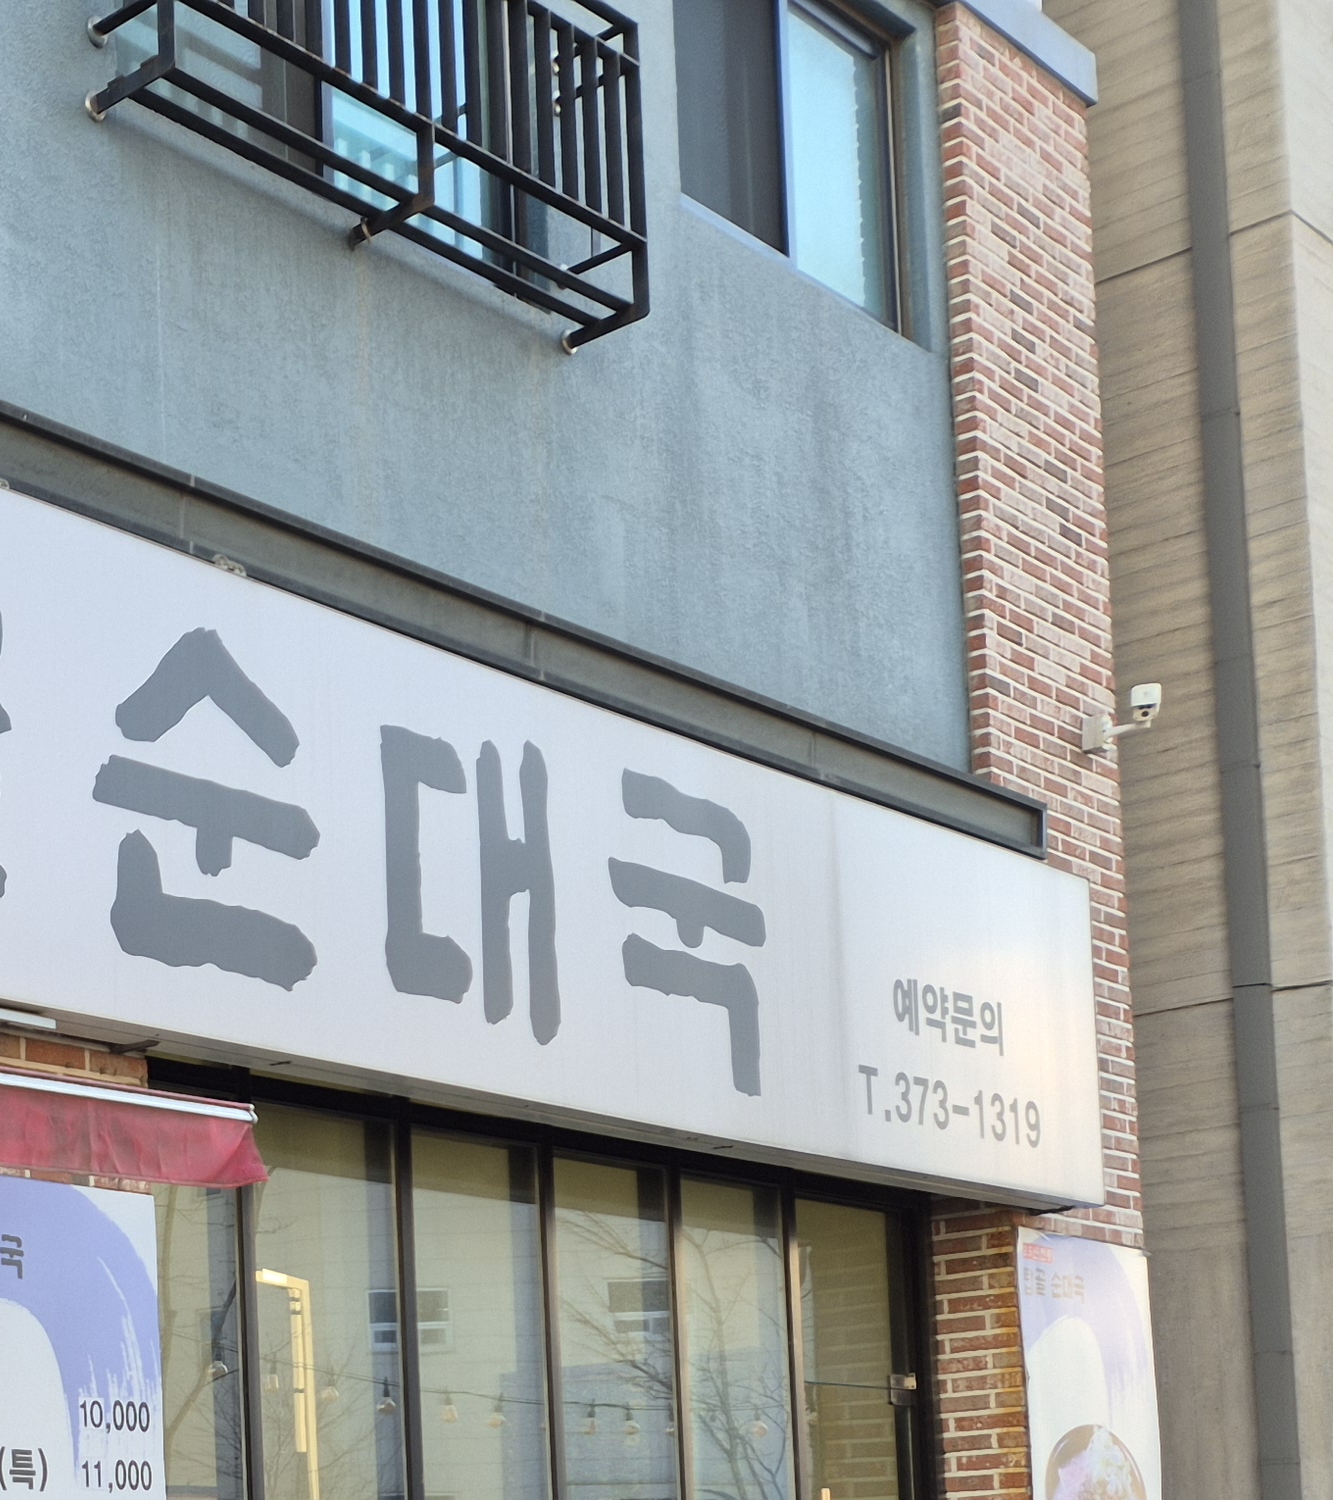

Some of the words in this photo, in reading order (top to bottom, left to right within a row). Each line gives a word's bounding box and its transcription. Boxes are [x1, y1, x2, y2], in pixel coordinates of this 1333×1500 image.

[92, 627, 766, 1097] 순대국
[893, 978, 1004, 1056] 예약문의
[858, 1064, 1041, 1149] T.373-1319
[79, 1400, 151, 1433] 10,000
[81, 1460, 153, 1493] 11,000
